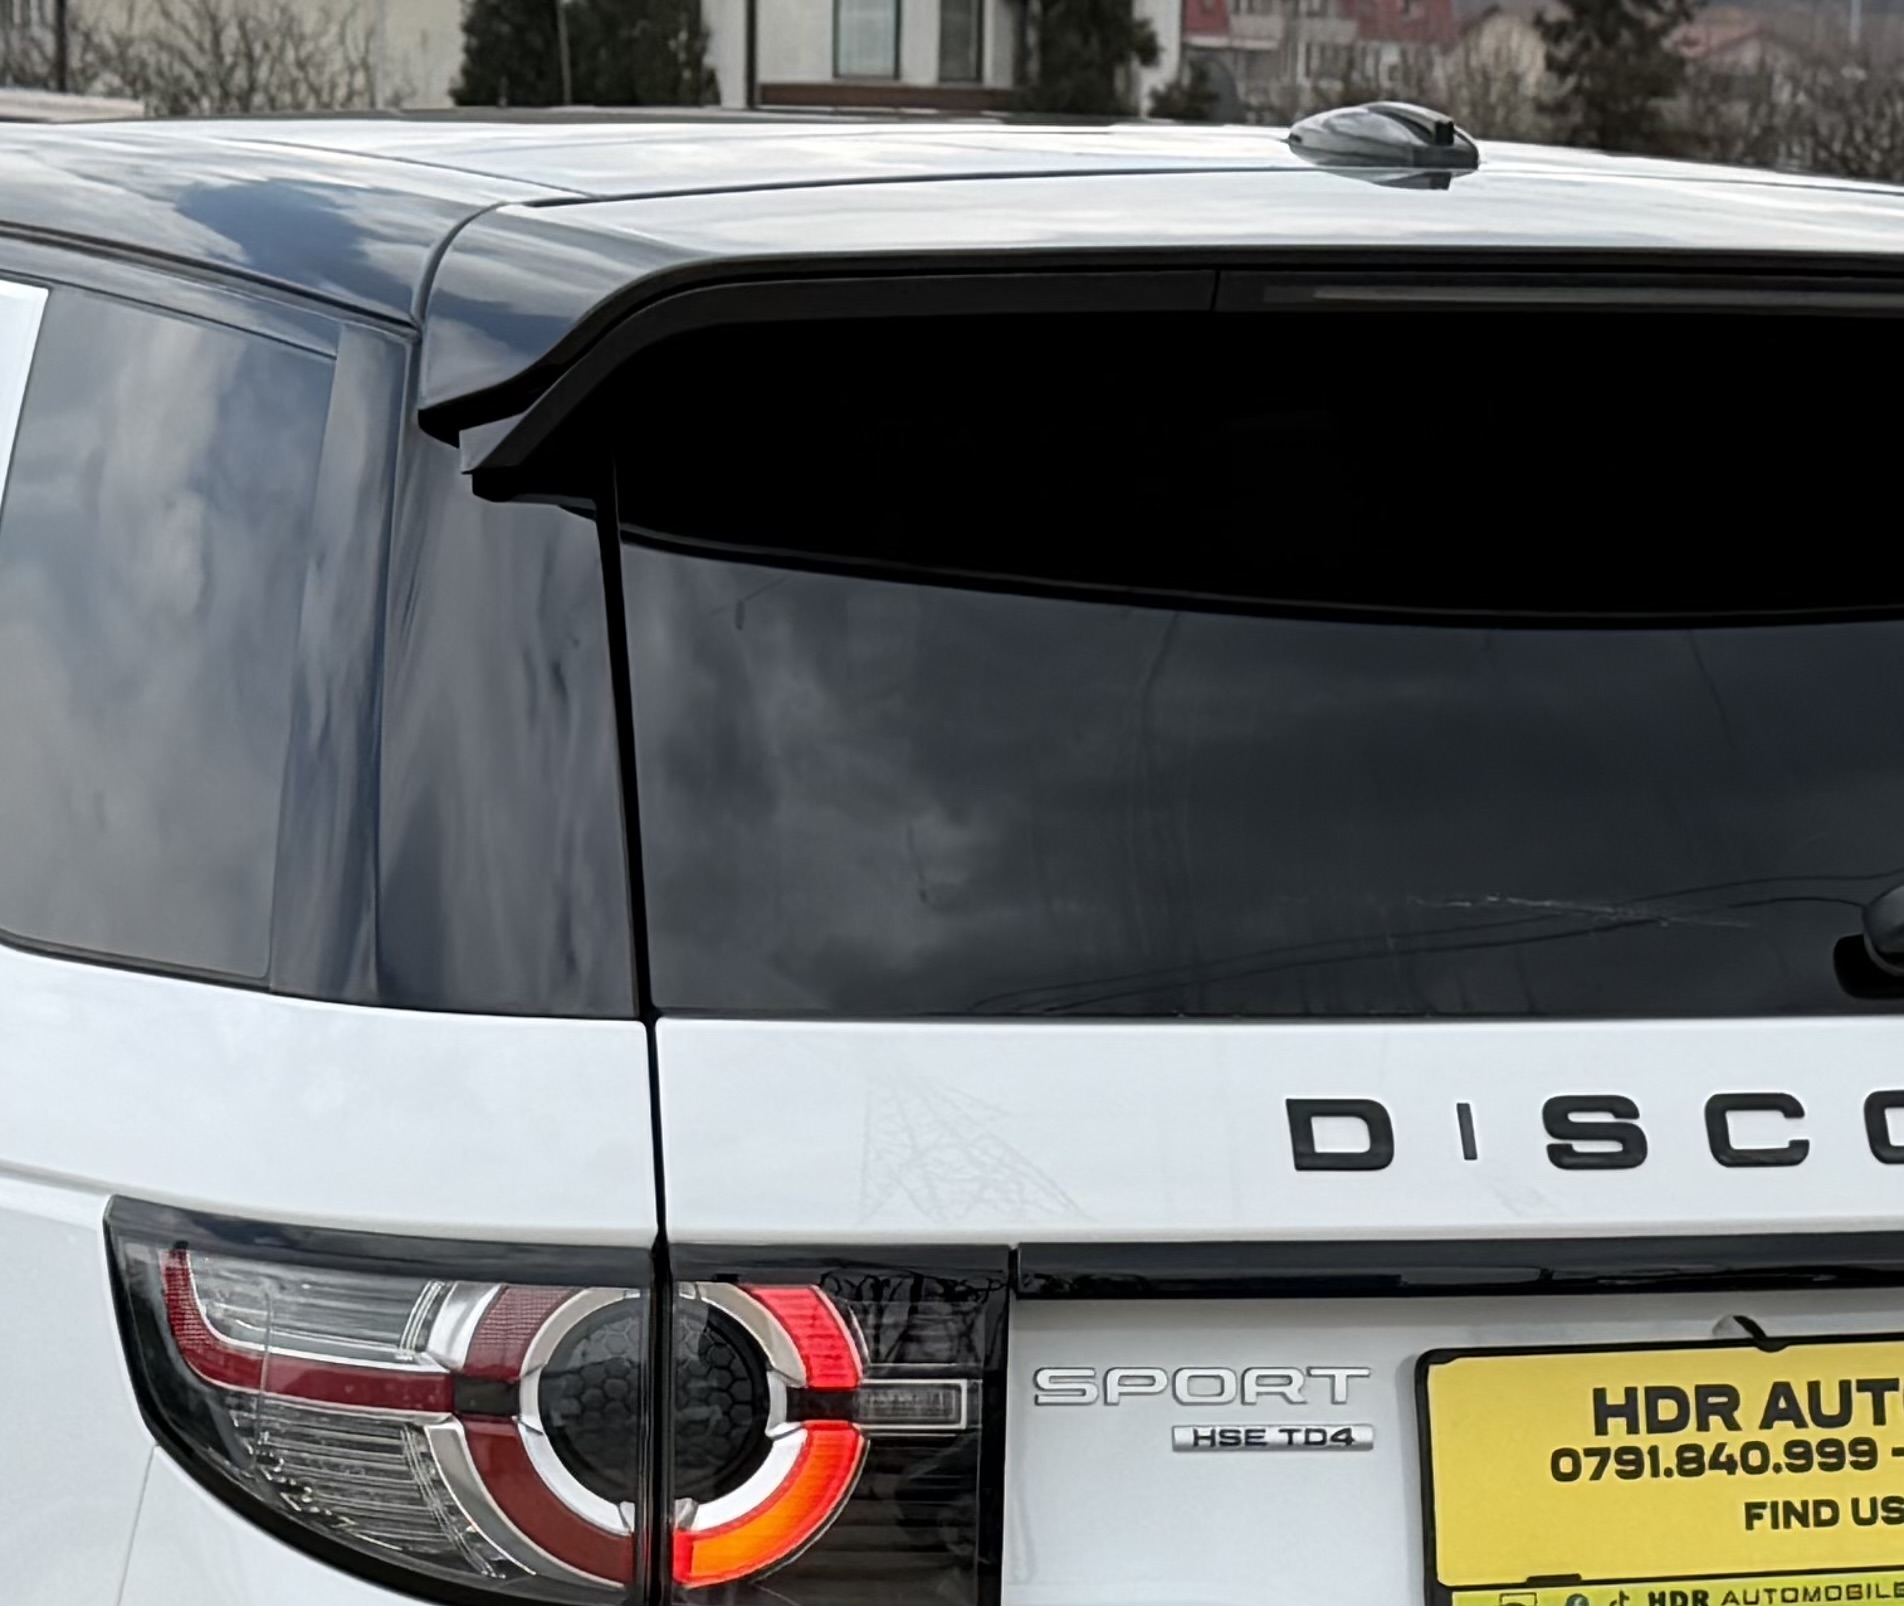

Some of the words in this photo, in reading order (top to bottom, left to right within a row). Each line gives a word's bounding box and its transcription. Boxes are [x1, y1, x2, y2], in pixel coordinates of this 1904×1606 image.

[1034, 1367, 1371, 1407] SPORT
[1593, 1384, 1741, 1436] HDR
[1193, 1428, 1269, 1448] HSE
[1279, 1428, 1356, 1448] TD4
[1551, 1437, 1878, 1482] 0791.840.999
[1744, 1500, 1840, 1531] FIND
